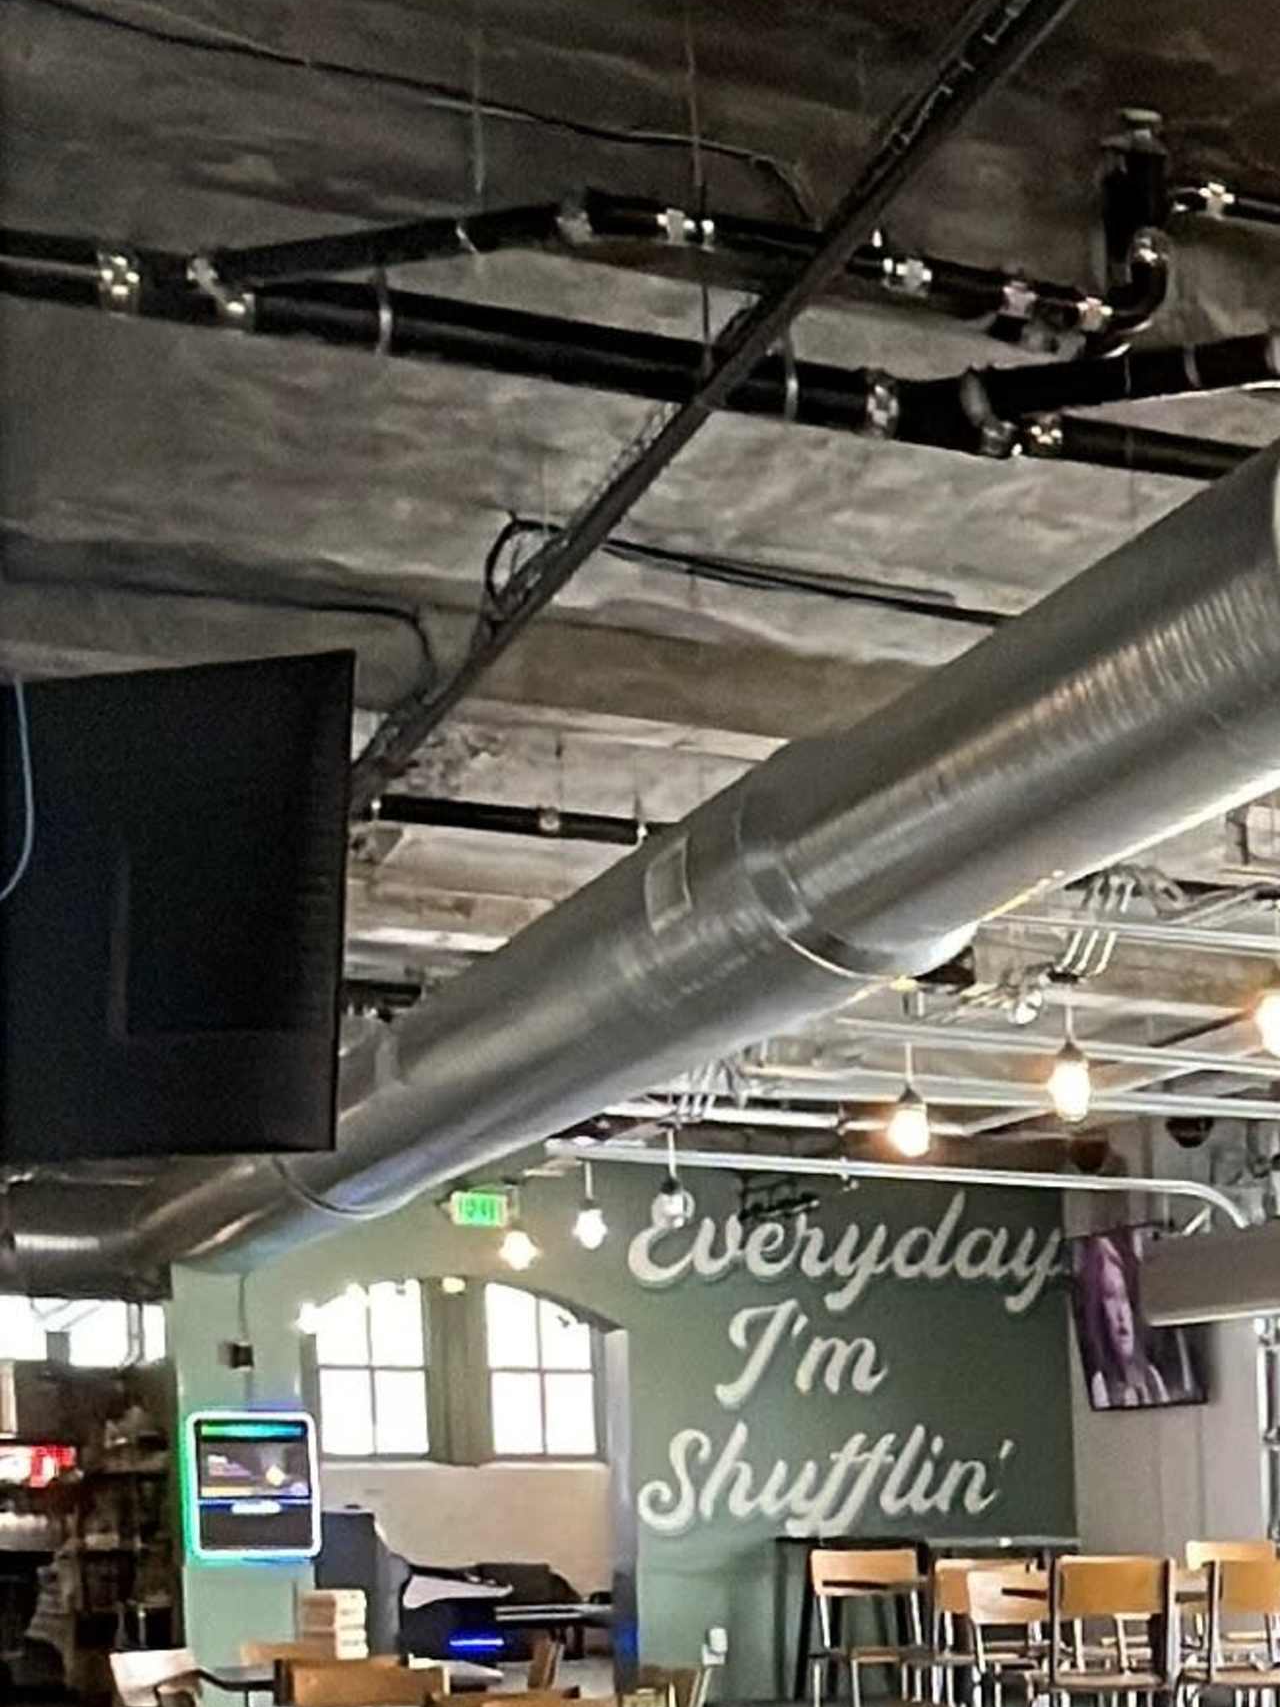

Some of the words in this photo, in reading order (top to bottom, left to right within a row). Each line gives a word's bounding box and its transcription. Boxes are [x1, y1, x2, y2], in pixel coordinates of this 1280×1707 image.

[627, 1190, 1066, 1313] Everyday
[715, 1298, 889, 1411] I'm
[637, 1420, 1014, 1538] Shufflin'
